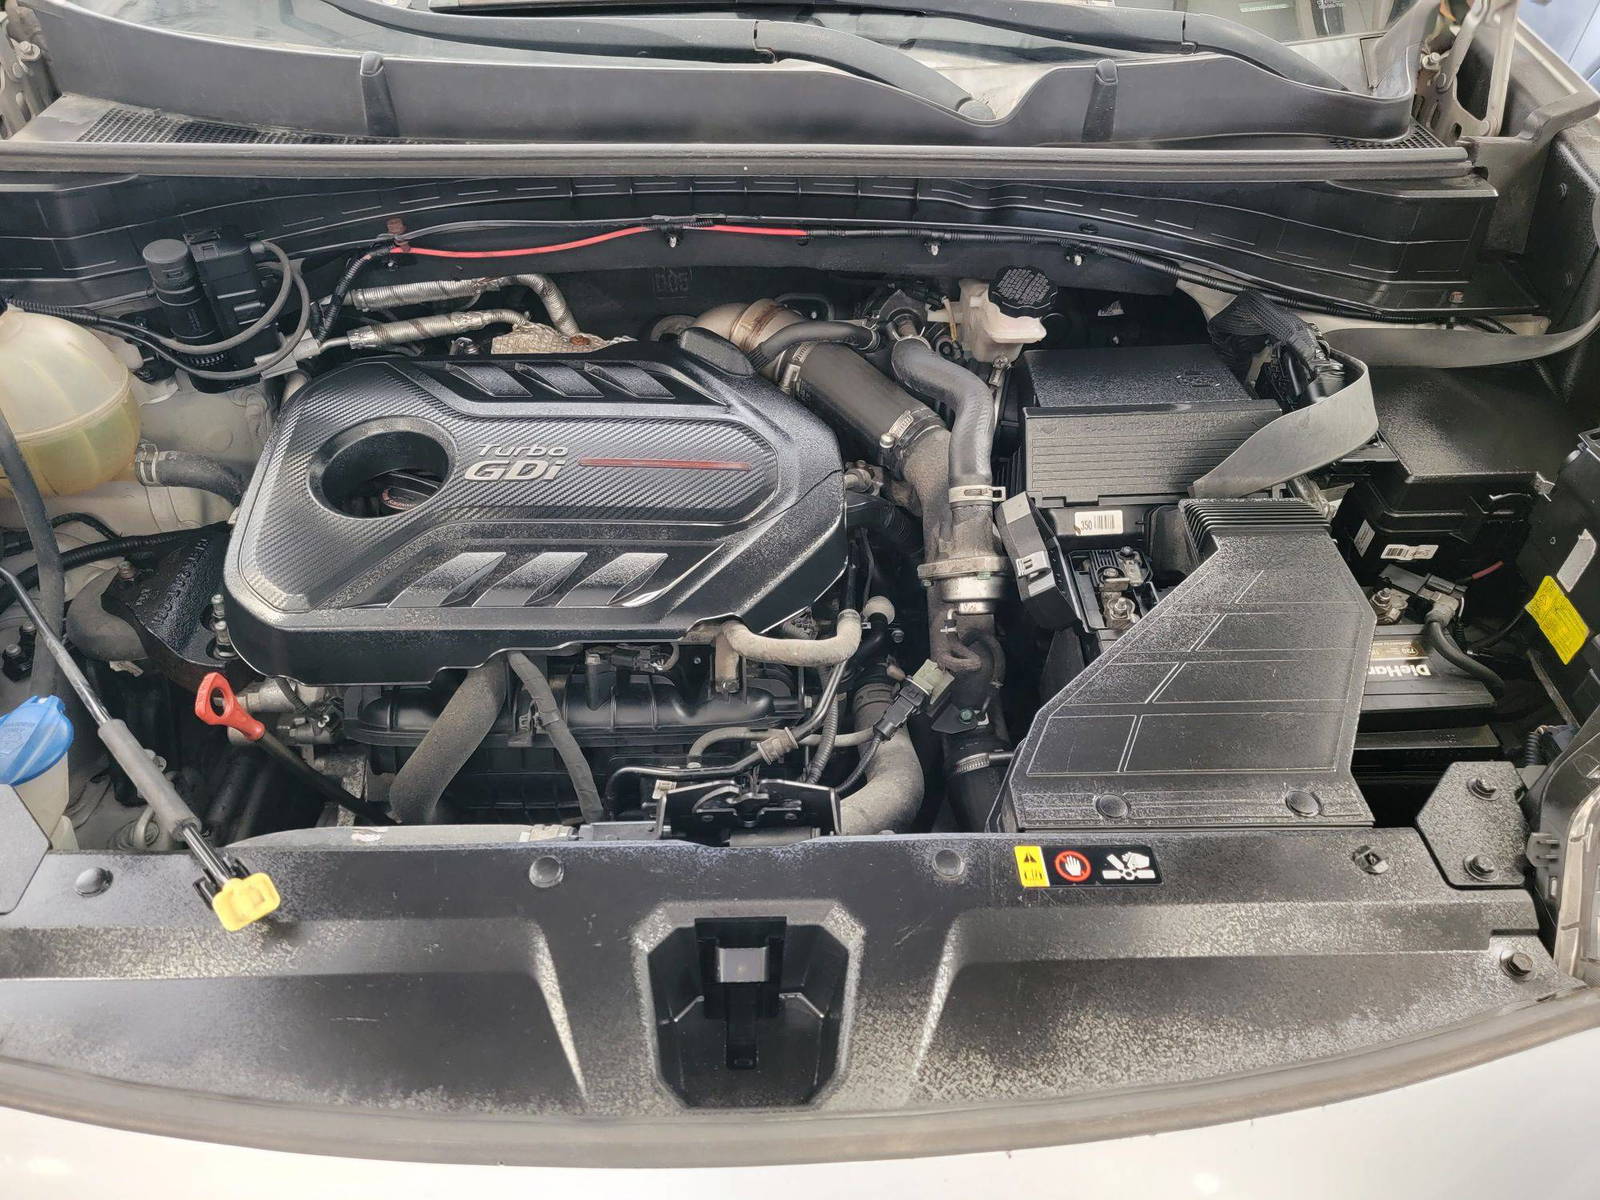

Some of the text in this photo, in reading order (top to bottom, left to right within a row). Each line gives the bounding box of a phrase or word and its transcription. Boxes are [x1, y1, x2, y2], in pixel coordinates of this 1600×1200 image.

[479, 443, 569, 457] Turbo
[464, 460, 566, 481] GDi
[1368, 664, 1432, 677] DieHar
